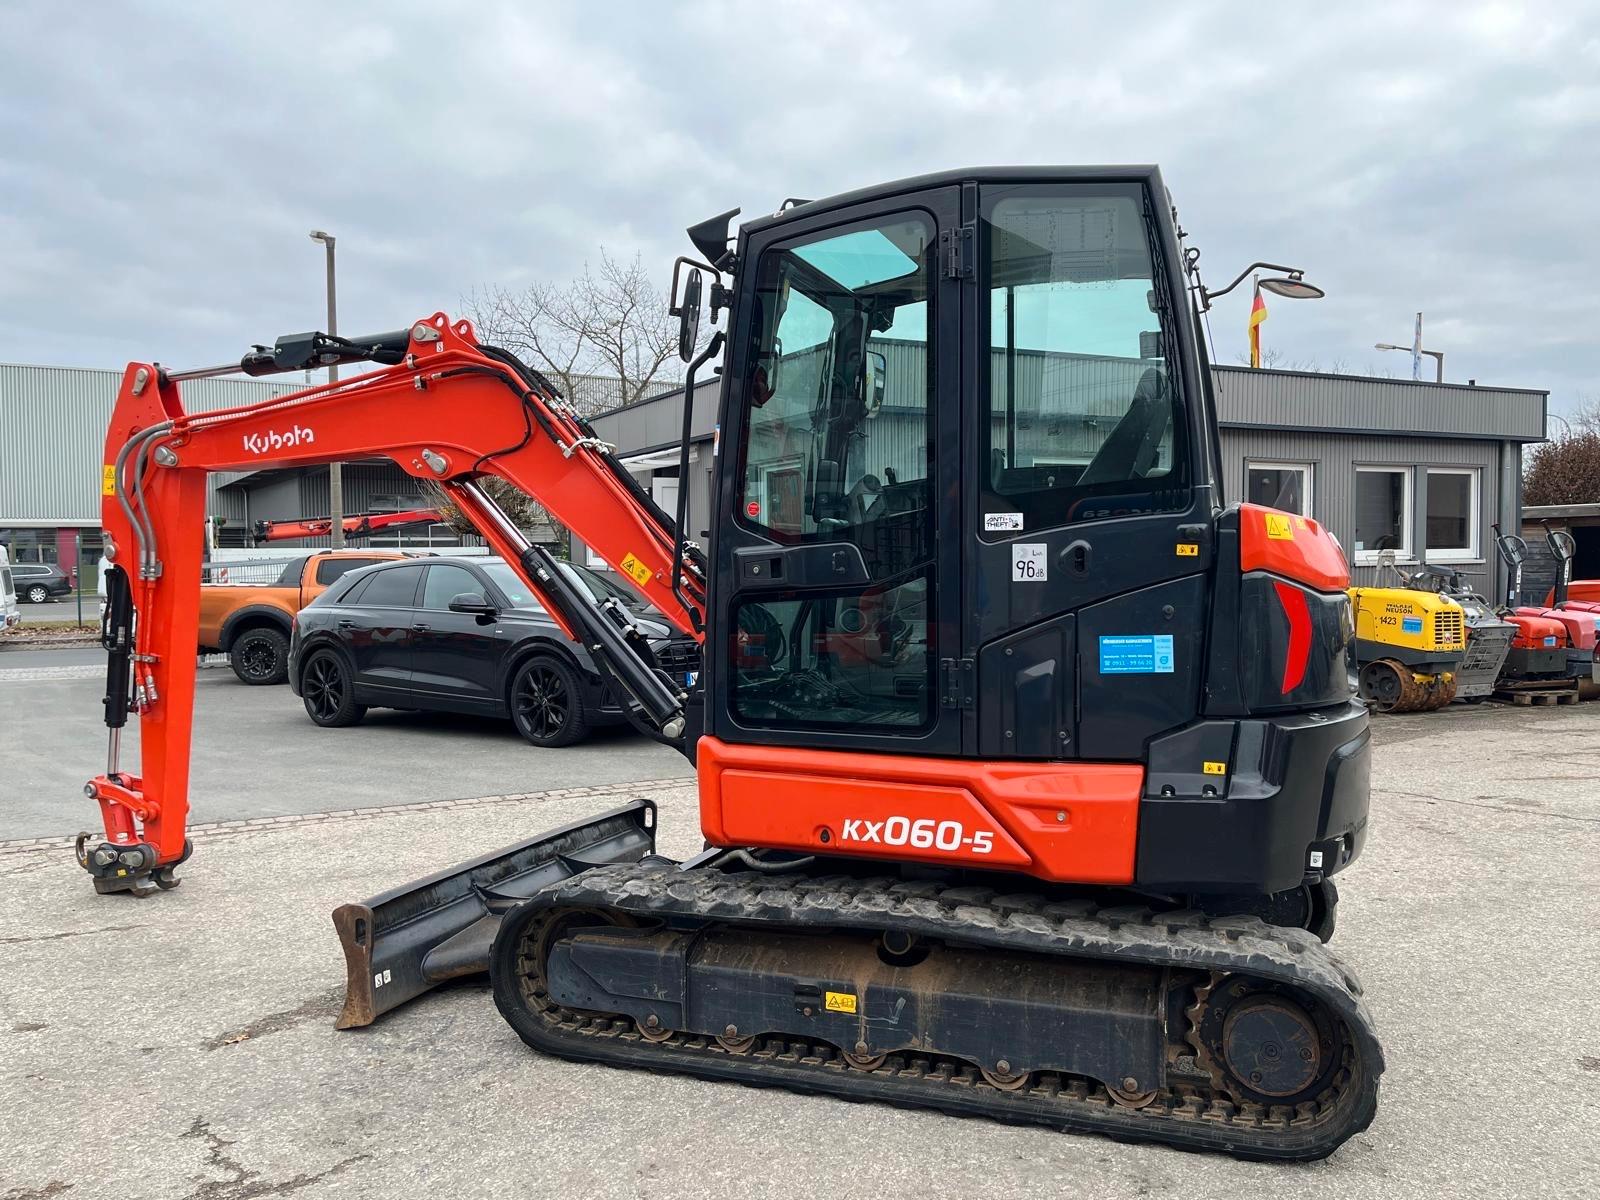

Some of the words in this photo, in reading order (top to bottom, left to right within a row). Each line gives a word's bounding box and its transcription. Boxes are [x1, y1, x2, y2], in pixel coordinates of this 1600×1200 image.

[243, 424, 314, 454] Kubota
[1016, 560, 1035, 578] 96
[1036, 568, 1045, 578] dB
[1380, 616, 1397, 625] 1423
[842, 816, 994, 854] KX060-5
